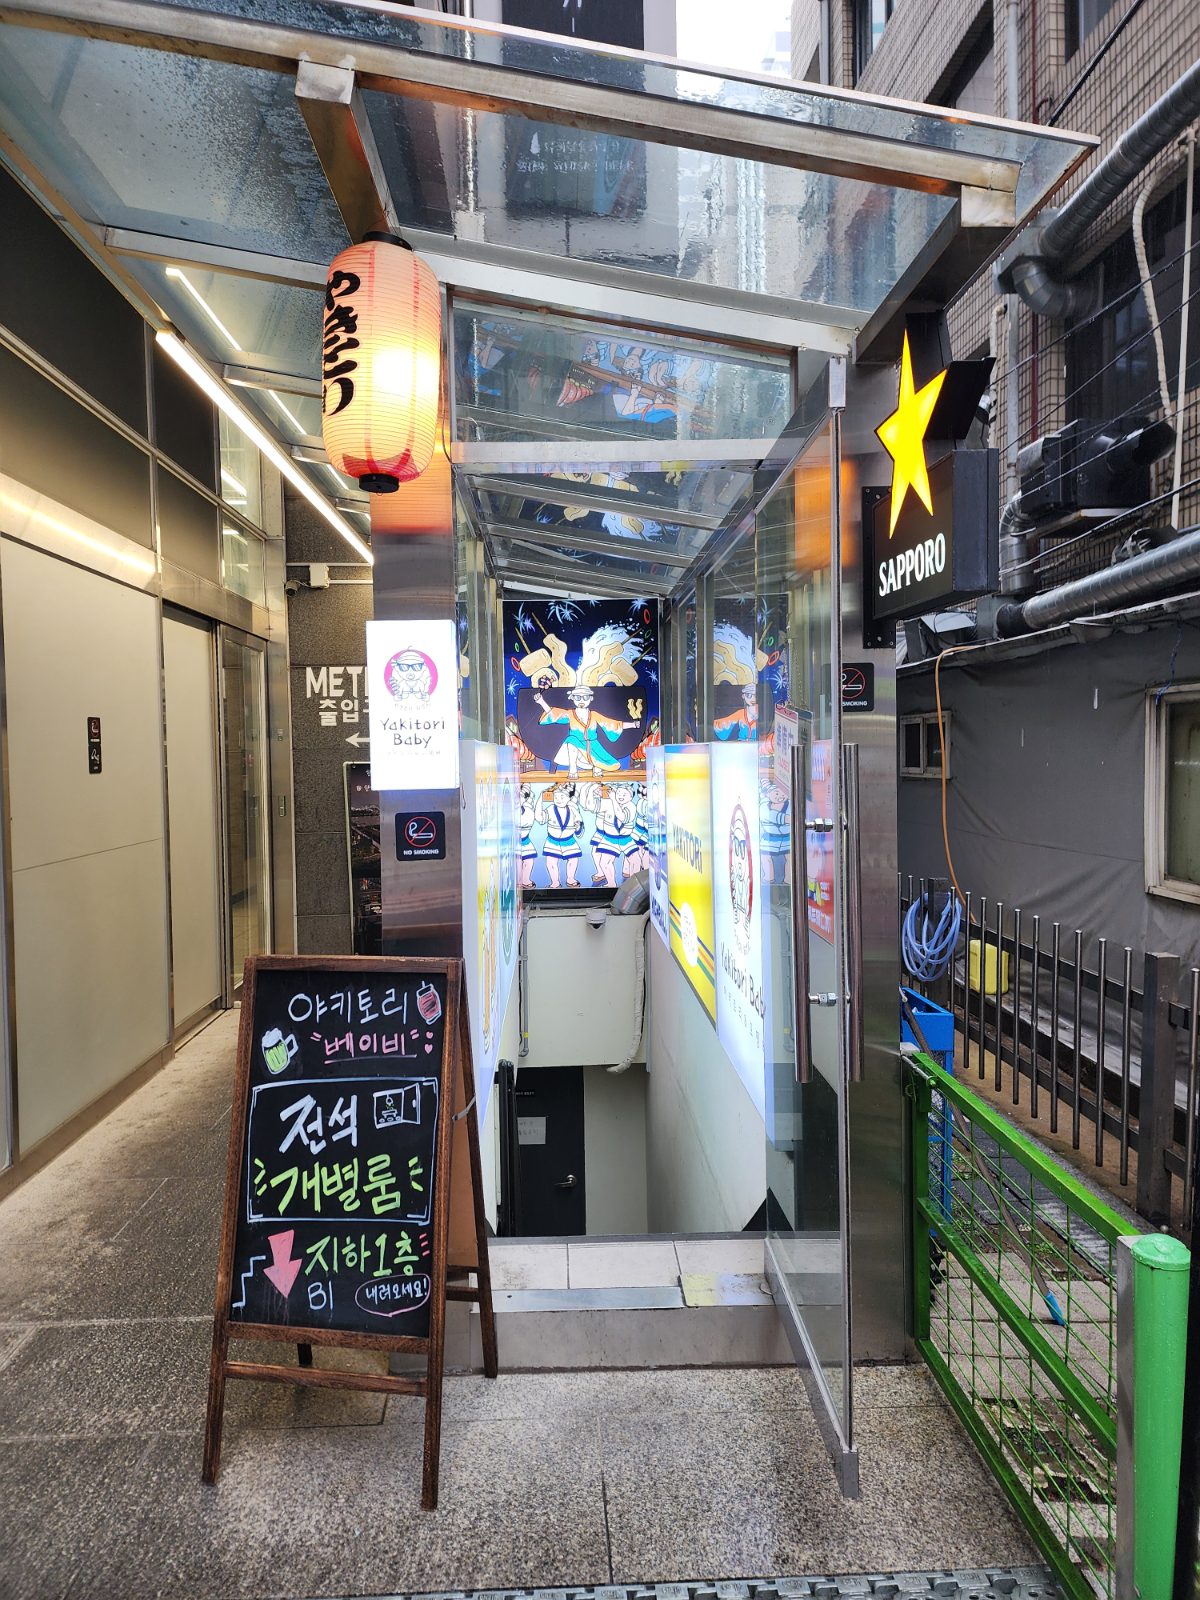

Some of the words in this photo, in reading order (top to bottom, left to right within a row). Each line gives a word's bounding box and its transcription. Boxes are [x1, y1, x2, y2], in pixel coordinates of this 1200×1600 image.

[879, 533, 946, 597] SAPPORO
[306, 666, 369, 698] MET
[380, 717, 445, 731] Yakitori
[393, 733, 432, 749] Baby
[288, 988, 408, 1025] 야키토리
[279, 1094, 358, 1155] 전석
[269, 1154, 401, 1216] 개별룸
[304, 1230, 420, 1277] 지하1층
[365, 1277, 428, 1305] 내려오세요!
